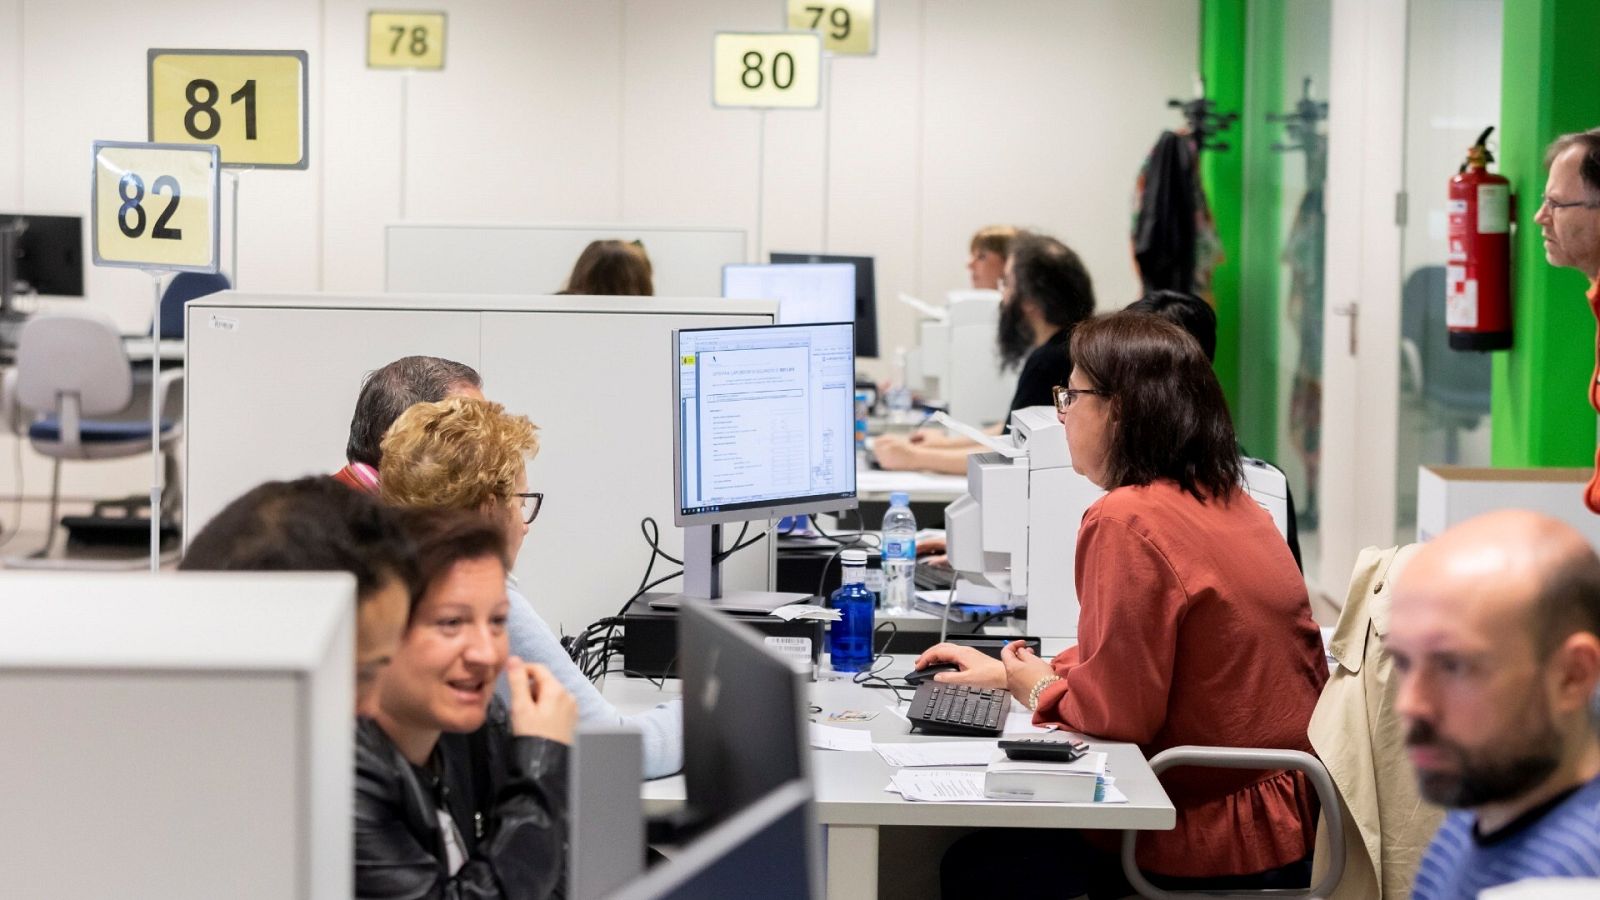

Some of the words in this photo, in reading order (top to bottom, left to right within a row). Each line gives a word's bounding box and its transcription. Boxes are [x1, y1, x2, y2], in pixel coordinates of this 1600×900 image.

[388, 25, 428, 57] 78
[805, 7, 851, 40] 79
[741, 51, 794, 89] 80
[184, 78, 257, 140] 81
[118, 172, 182, 240] 82
